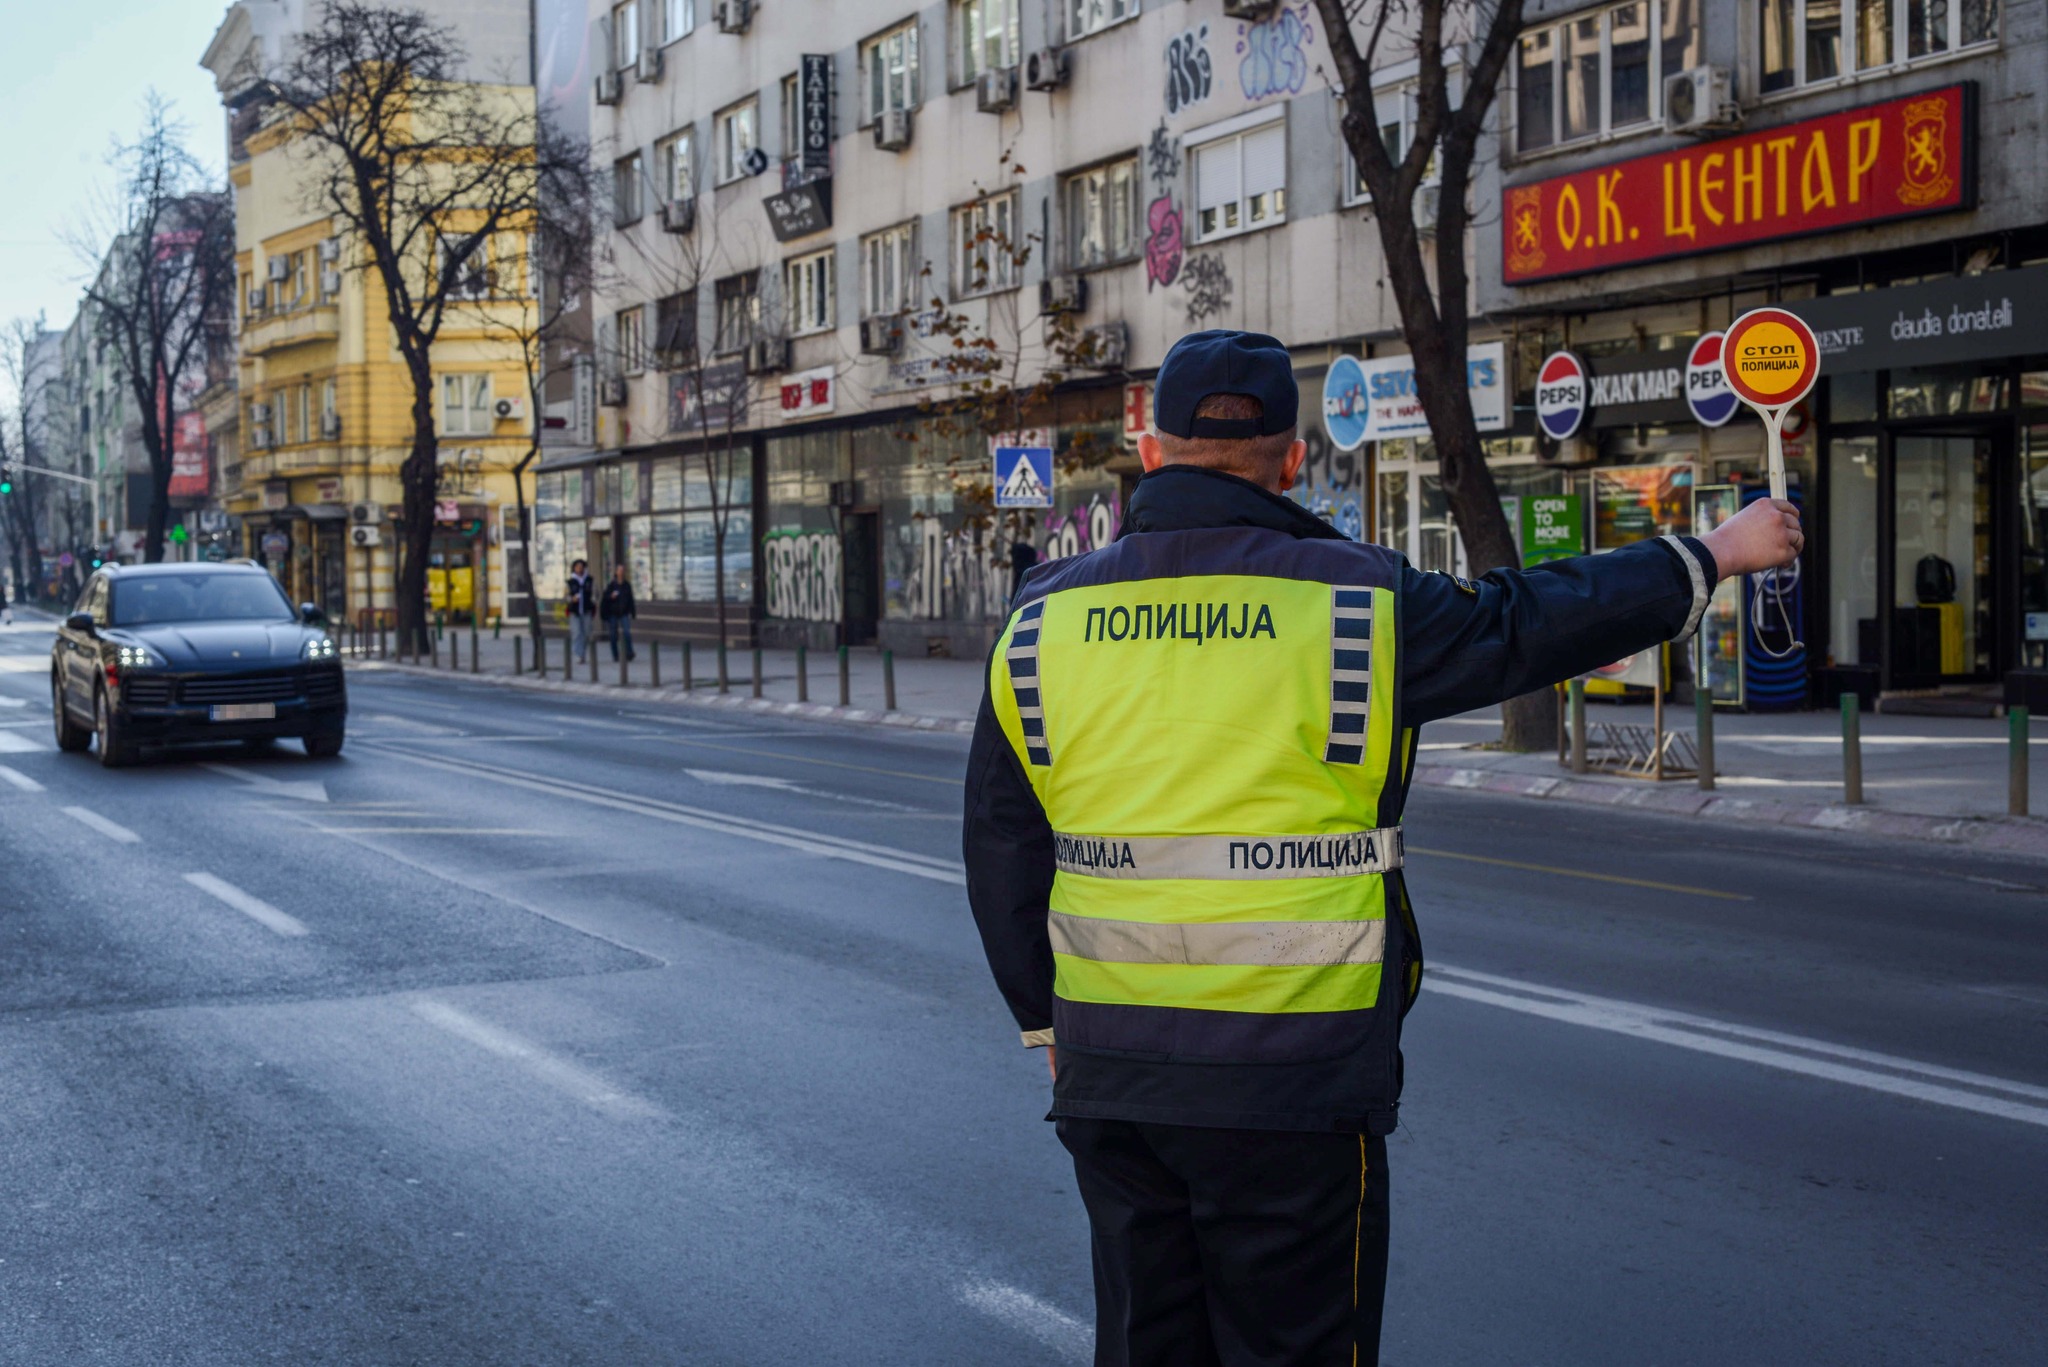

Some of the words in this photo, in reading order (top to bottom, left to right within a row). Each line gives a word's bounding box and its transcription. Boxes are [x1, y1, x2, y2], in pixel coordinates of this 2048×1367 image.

[806, 56, 825, 148] TATTOO
[1556, 169, 1640, 251] О.К.
[1663, 118, 1881, 241] ЦЕНТАР
[1890, 307, 1942, 341] claudia
[1947, 297, 2013, 334] donatelli
[1743, 344, 1796, 356] СТОП
[1741, 359, 1800, 372] ПОЛИЦИЈА
[1540, 385, 1582, 406] PEPSI
[1589, 374, 1635, 408] ЖАК
[1636, 368, 1681, 402] МАР
[1532, 499, 1567, 513] OPEN
[1534, 513, 1554, 526] TO
[1535, 526, 1571, 540] MORE
[1085, 603, 1277, 645] ПОЛИЦИЈА
[1055, 836, 1136, 870] ОЛИЦИЈА
[1229, 836, 1378, 871] ПОЛИЦИЈА
